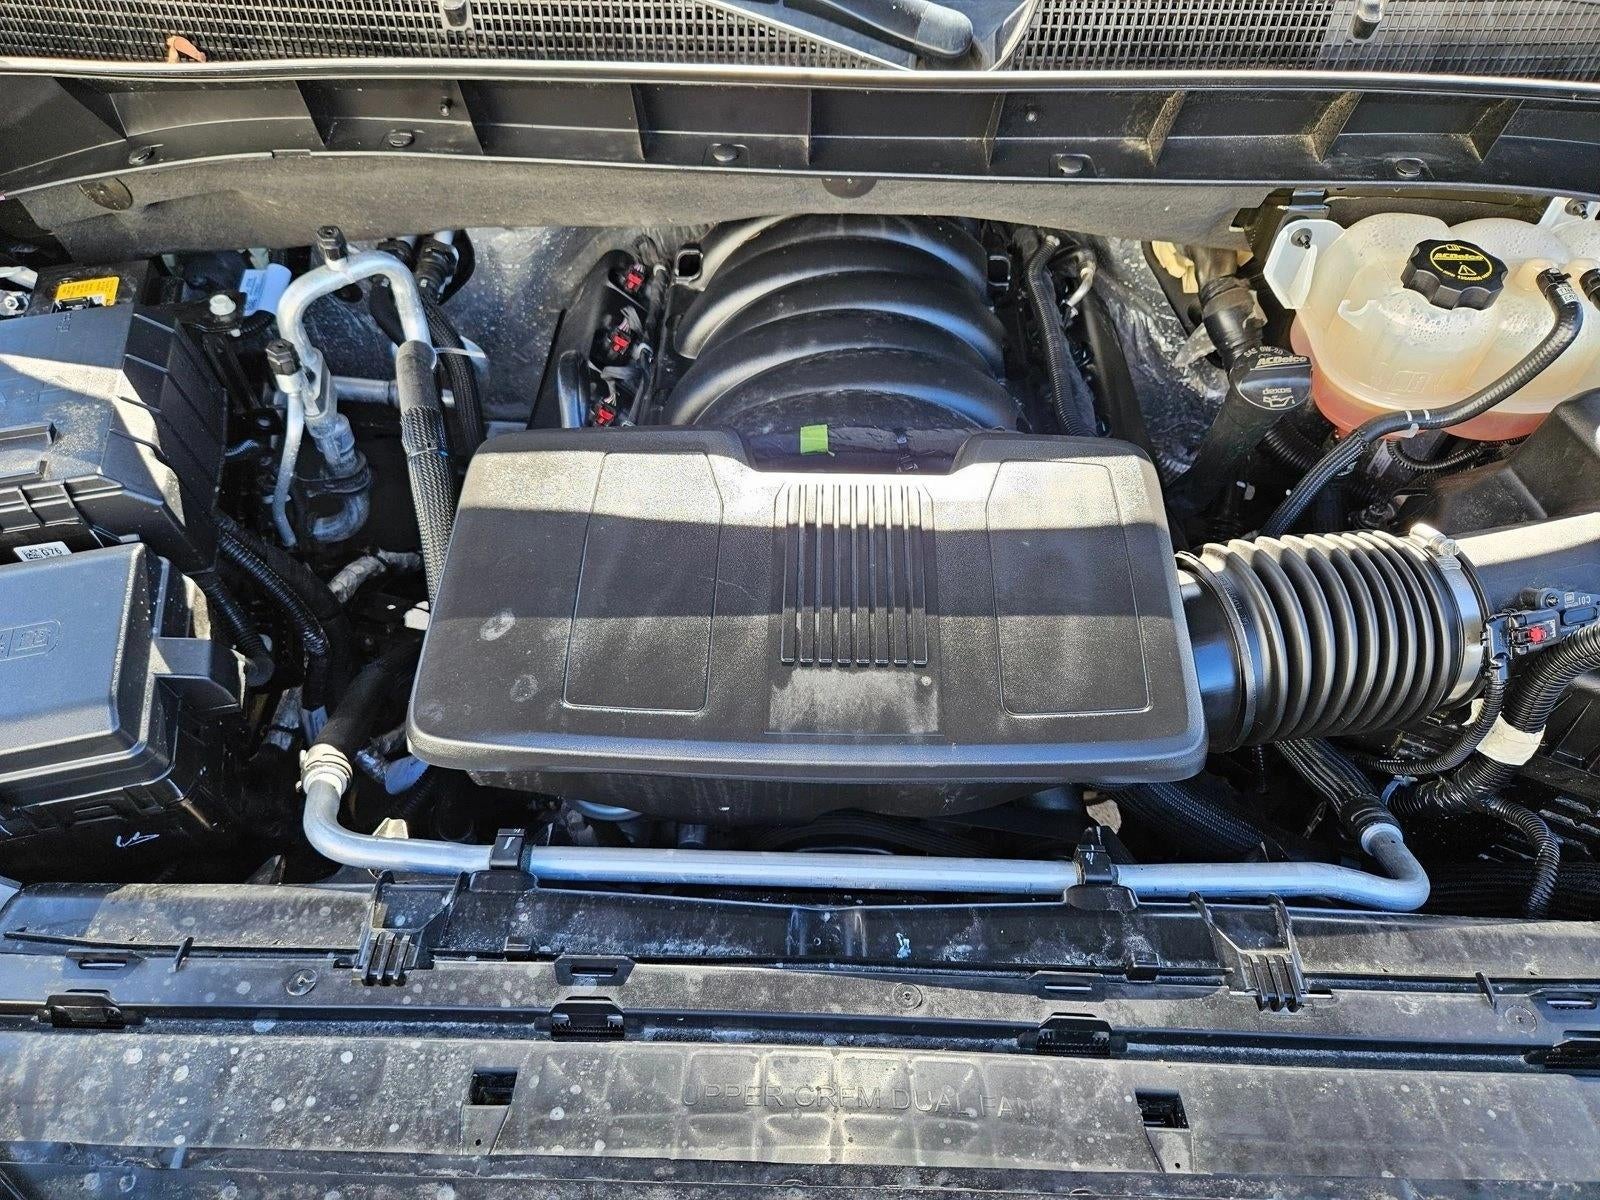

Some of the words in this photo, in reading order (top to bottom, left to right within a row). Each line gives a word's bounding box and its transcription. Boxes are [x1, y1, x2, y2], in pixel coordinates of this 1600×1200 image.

[1433, 252, 1484, 261] ACDelco
[1243, 348, 1258, 358] SAE
[1257, 355, 1308, 366] ACDelco
[1262, 387, 1292, 395] dexos
[682, 1084, 784, 1107] UPPER
[892, 1088, 970, 1117] DUAL
